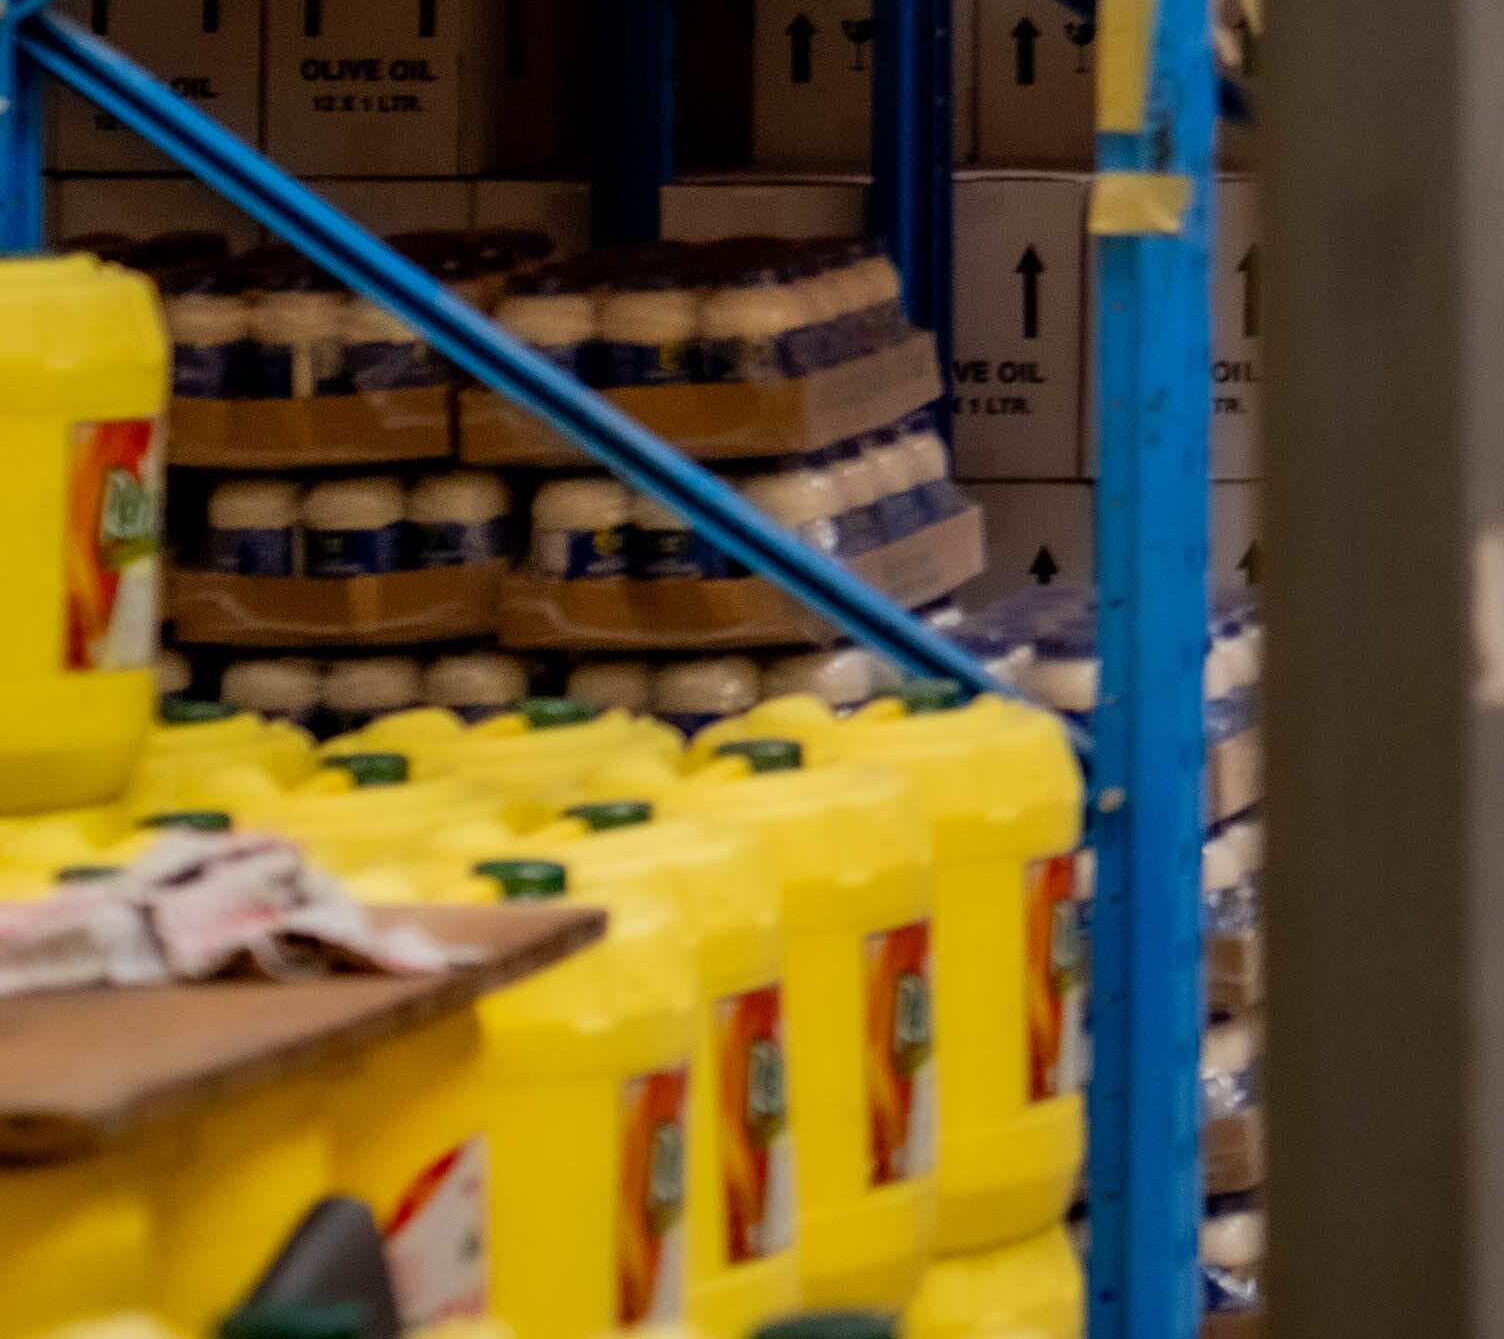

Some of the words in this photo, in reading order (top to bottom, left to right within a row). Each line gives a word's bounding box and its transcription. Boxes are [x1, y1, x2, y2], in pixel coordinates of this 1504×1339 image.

[300, 59, 382, 82] OLIVE
[389, 59, 438, 82] OIL
[997, 361, 1044, 384] OIL
